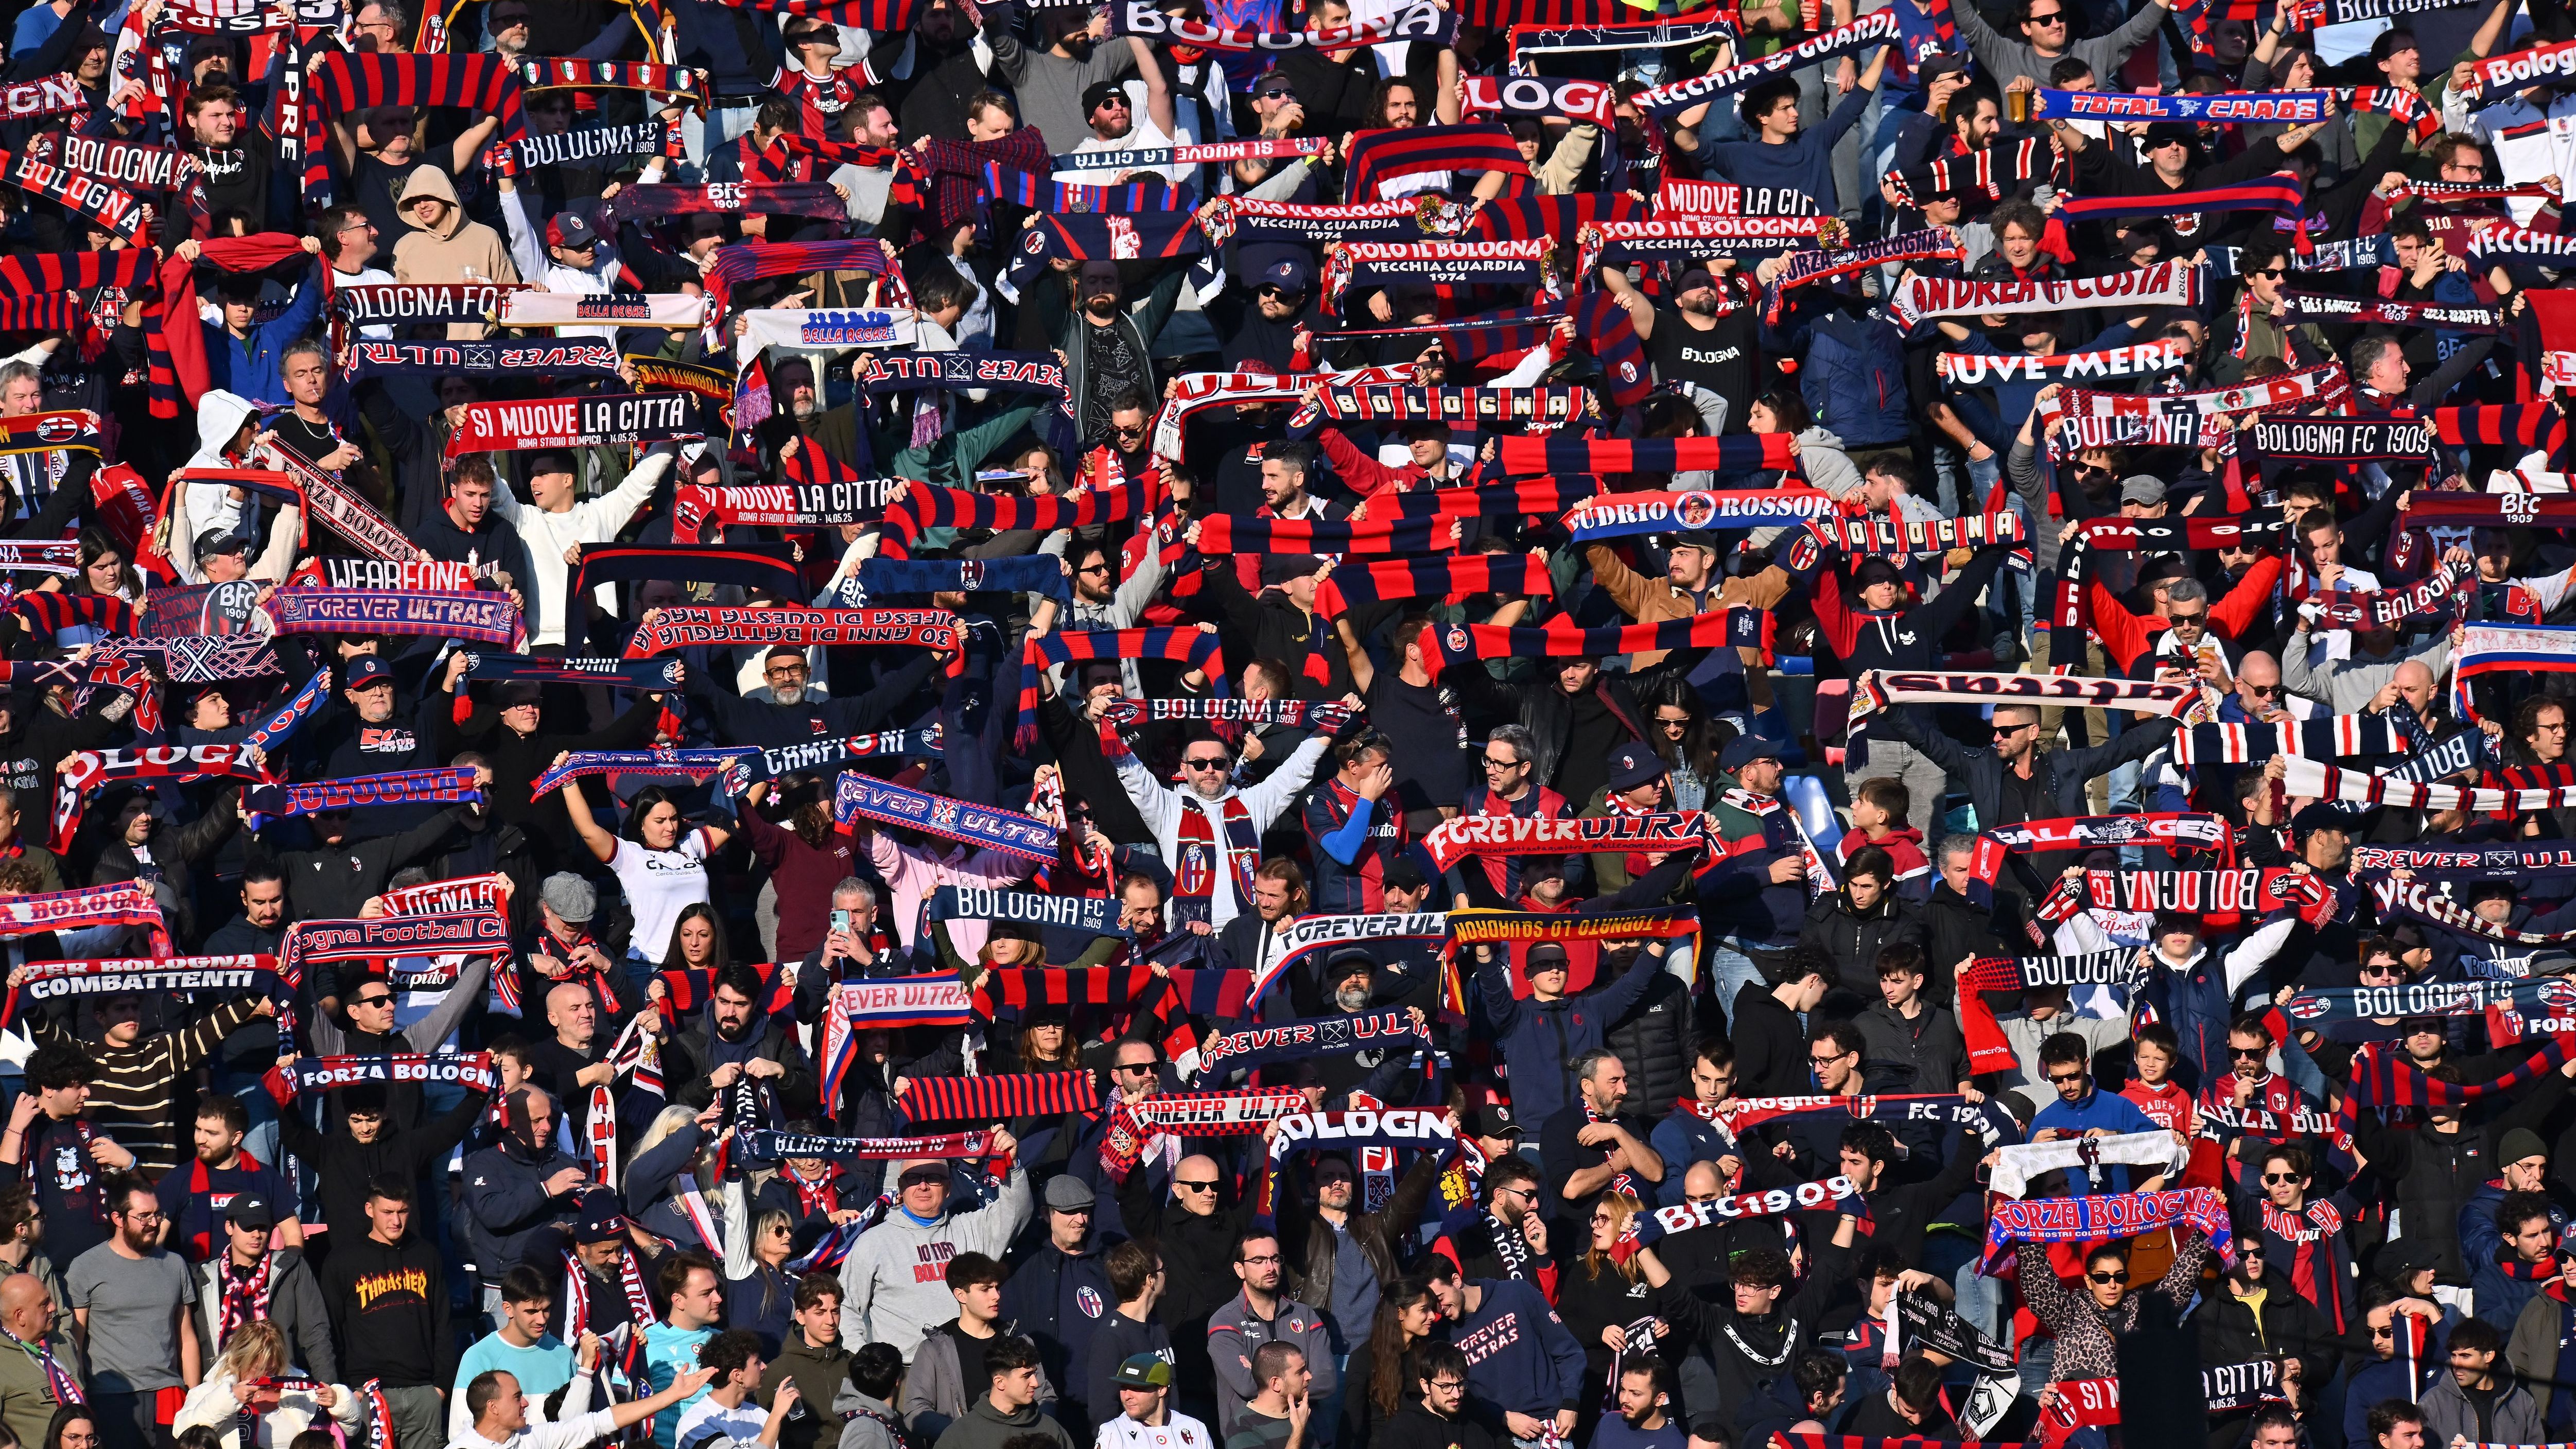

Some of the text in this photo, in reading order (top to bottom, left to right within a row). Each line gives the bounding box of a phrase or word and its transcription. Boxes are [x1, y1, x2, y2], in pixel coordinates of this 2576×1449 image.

[1127, 1, 1439, 50] BOLOGNA
[1631, 64, 1760, 108] VECCHIA
[2072, 95, 2317, 119] TOTAL CHAOS
[636, 141, 655, 153] 1909
[1143, 149, 1168, 162] LA
[1177, 143, 1244, 160] MUOVE
[1255, 142, 1274, 155] SI
[64, 135, 173, 184] BOLOGNA
[16, 158, 142, 233] BOLOGNA
[707, 182, 747, 200] BFC
[1668, 183, 1771, 214] MUOVE LA
[713, 200, 740, 208] 1909
[1234, 197, 1286, 215] SOLO
[1311, 199, 1416, 217] BOLOGNA
[1248, 217, 1400, 231] VECCHIA GUARDIA
[1602, 217, 1817, 237] SOLO IL BOLOGNA
[1306, 231, 1342, 240] 1974
[1622, 237, 1800, 251] VECCHIA GUARDIA
[1858, 229, 1937, 261] BOLOGNA
[1349, 240, 1541, 258] SOLO IL BOLOGNA
[1368, 259, 1526, 273] VECCHIA GUARDIA
[2357, 255, 2376, 265] 1909
[1430, 272, 1466, 282] 1974
[1912, 261, 2172, 313] ANDREA COSTA
[578, 305, 645, 317] BELLA REGAZ
[2385, 312, 2407, 321] 1909
[802, 327, 843, 343] BELLA
[846, 326, 889, 342] REGAZ
[1336, 394, 1567, 415] BOLOGNA
[471, 394, 685, 437] SI MUOVE LA CITTÀ
[517, 432, 638, 448] ROMA STADIO OLIMPICO 14.05.25
[2256, 424, 2429, 453] BOLOGNA FC 1909
[305, 465, 324, 482] DACCI
[340, 489, 355, 504] GIOIA
[360, 504, 377, 520] DELLA
[384, 521, 409, 542] VITTORIA
[722, 485, 825, 511] MUOVE LA
[2501, 493, 2541, 514] BFC
[738, 512, 852, 523] ROMA STADIO OLIMPICO 14.05.25
[2506, 514, 2533, 523] 1909
[311, 507, 375, 552] COLORI SPLENDERANNO
[220, 582, 255, 611] BFC
[225, 608, 246, 619] 1909
[304, 599, 495, 625] FOREVER ULTRAS
[722, 610, 825, 624] QUESTA
[836, 613, 859, 624] DI
[659, 627, 951, 645] 30 ANNI DI BATTAGLIA
[1154, 699, 1300, 723] BOLOGNA FC
[1275, 714, 1296, 724] 1909
[1426, 815, 1580, 861] FOREVER
[2095, 869, 2259, 911] BOLOGNA FC
[956, 886, 1104, 925] BOLOGNA FC
[2375, 878, 2504, 938] VECCHIA
[365, 919, 472, 942] Football
[1084, 917, 1102, 930] 1909
[1551, 920, 1571, 937] LO
[1578, 916, 1656, 935] TORNATO
[2091, 915, 2143, 934] Saputo
[1278, 916, 1402, 951] FOREVER
[25, 955, 255, 981] PER BOLOGNA
[30, 971, 255, 999] COMBATTENTI
[388, 969, 448, 988] Saputo
[2491, 981, 2512, 998] FC
[1322, 1042, 1350, 1050] 1974-2024
[1972, 1046, 2007, 1057] macron
[303, 1066, 385, 1087] FORZA
[1908, 1102, 1940, 1120] F.C.
[1995, 1187, 2215, 1229] FORZA BOLOGNA
[917, 1244, 932, 1263] IO
[356, 1269, 427, 1310] THRASHER
[1924, 1299, 1938, 1317] 1909
[1934, 1330, 1963, 1348] CHAMPIONS
[1936, 1338, 1957, 1351] LEAGUE
[2079, 1383, 2102, 1409] SI
[2209, 1398, 2236, 1410] 14.05.25
